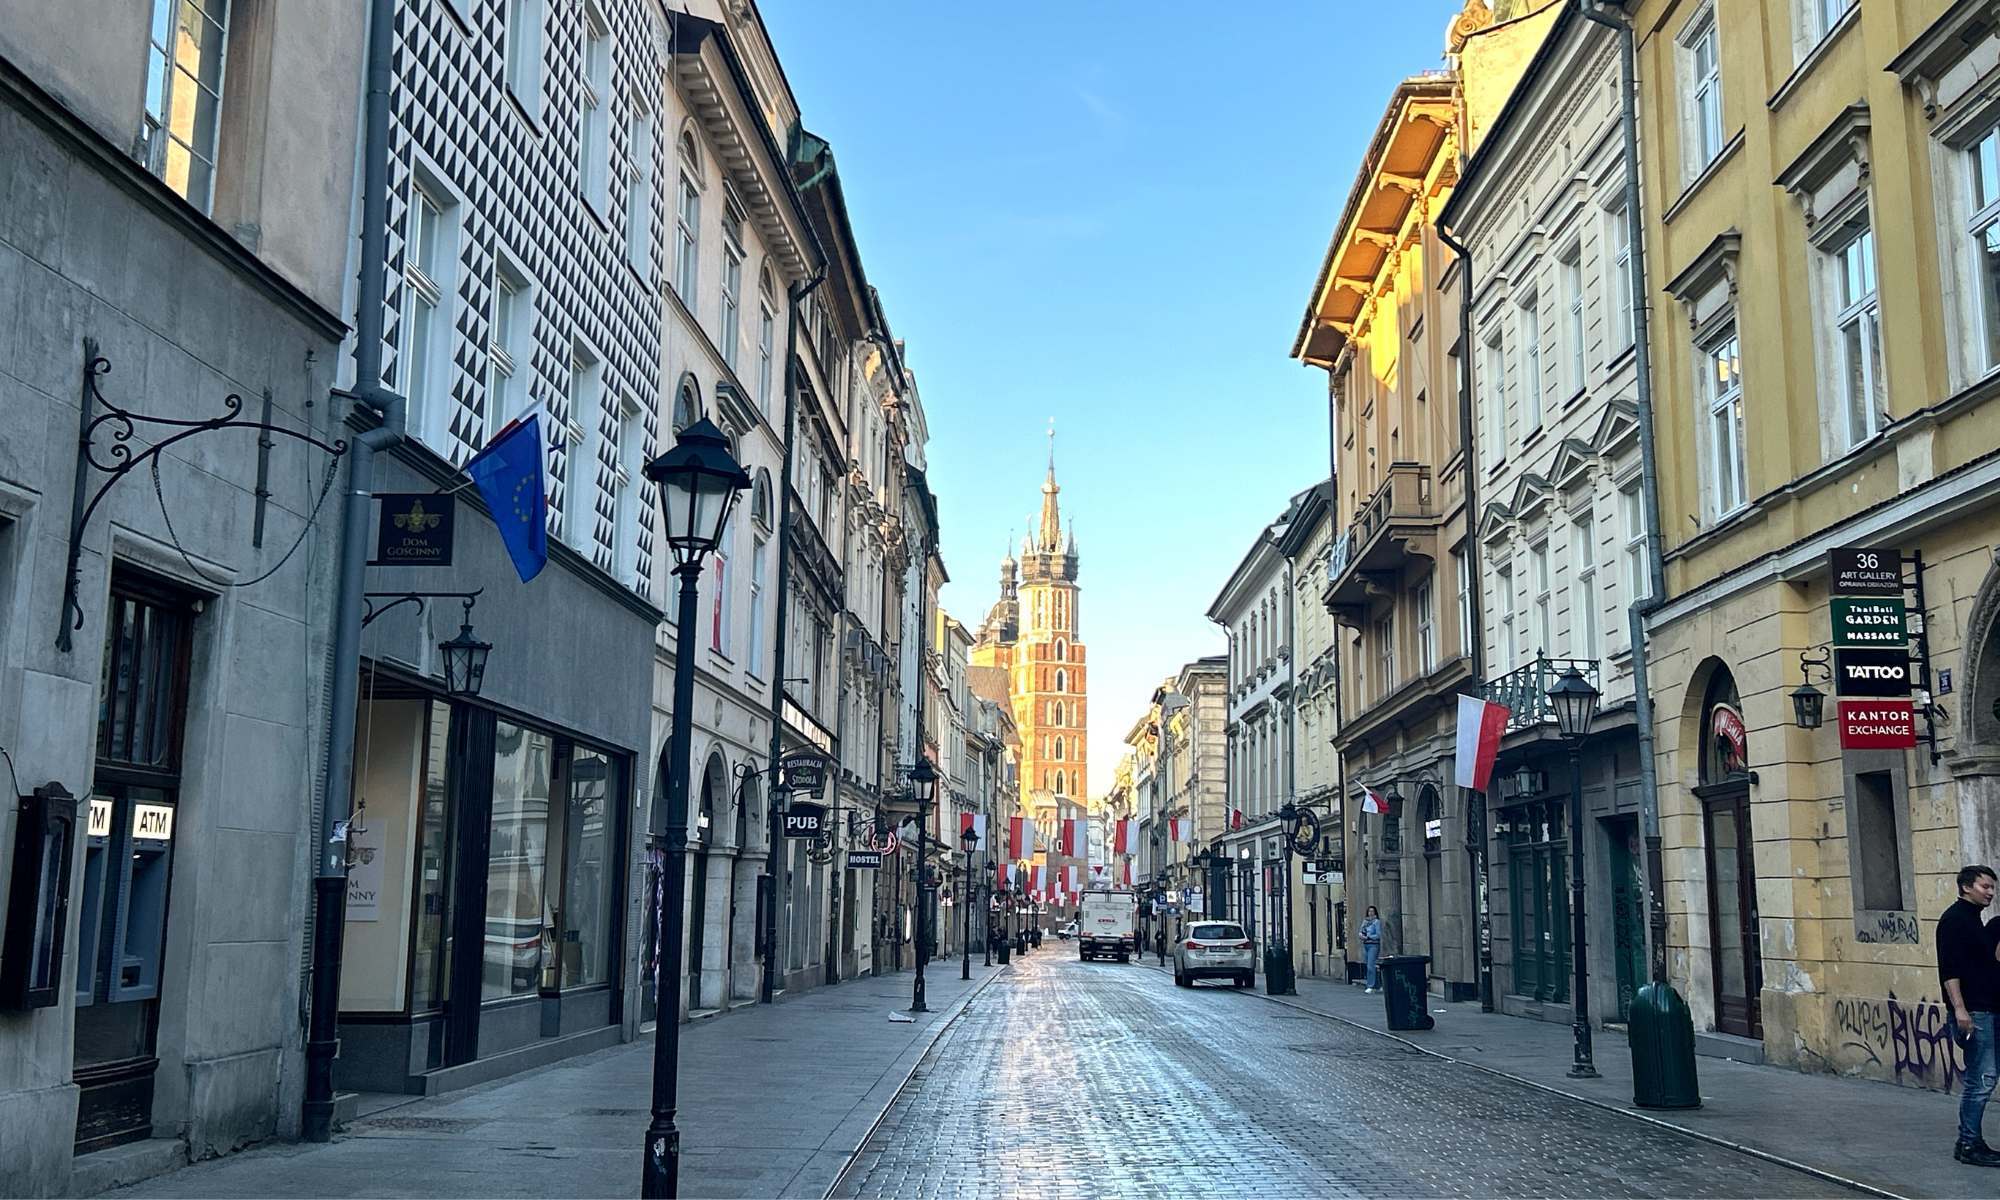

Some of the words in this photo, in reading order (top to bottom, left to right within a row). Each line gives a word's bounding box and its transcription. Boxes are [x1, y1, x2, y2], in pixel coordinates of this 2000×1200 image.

[403, 537, 428, 546] DOM
[1856, 553, 1879, 569] 36
[1840, 571, 1857, 579] ART
[1859, 571, 1897, 580] GALLERY
[1845, 615, 1899, 625] GARDEN
[1847, 632, 1900, 640] MASSAGE
[1846, 665, 1904, 679] TATTOO
[1847, 711, 1909, 721] KANTOR
[1848, 725, 1910, 735] EXCHANGE
[140, 811, 167, 833] ATM
[787, 817, 818, 829] PUB
[849, 855, 880, 864] HOSTEL
